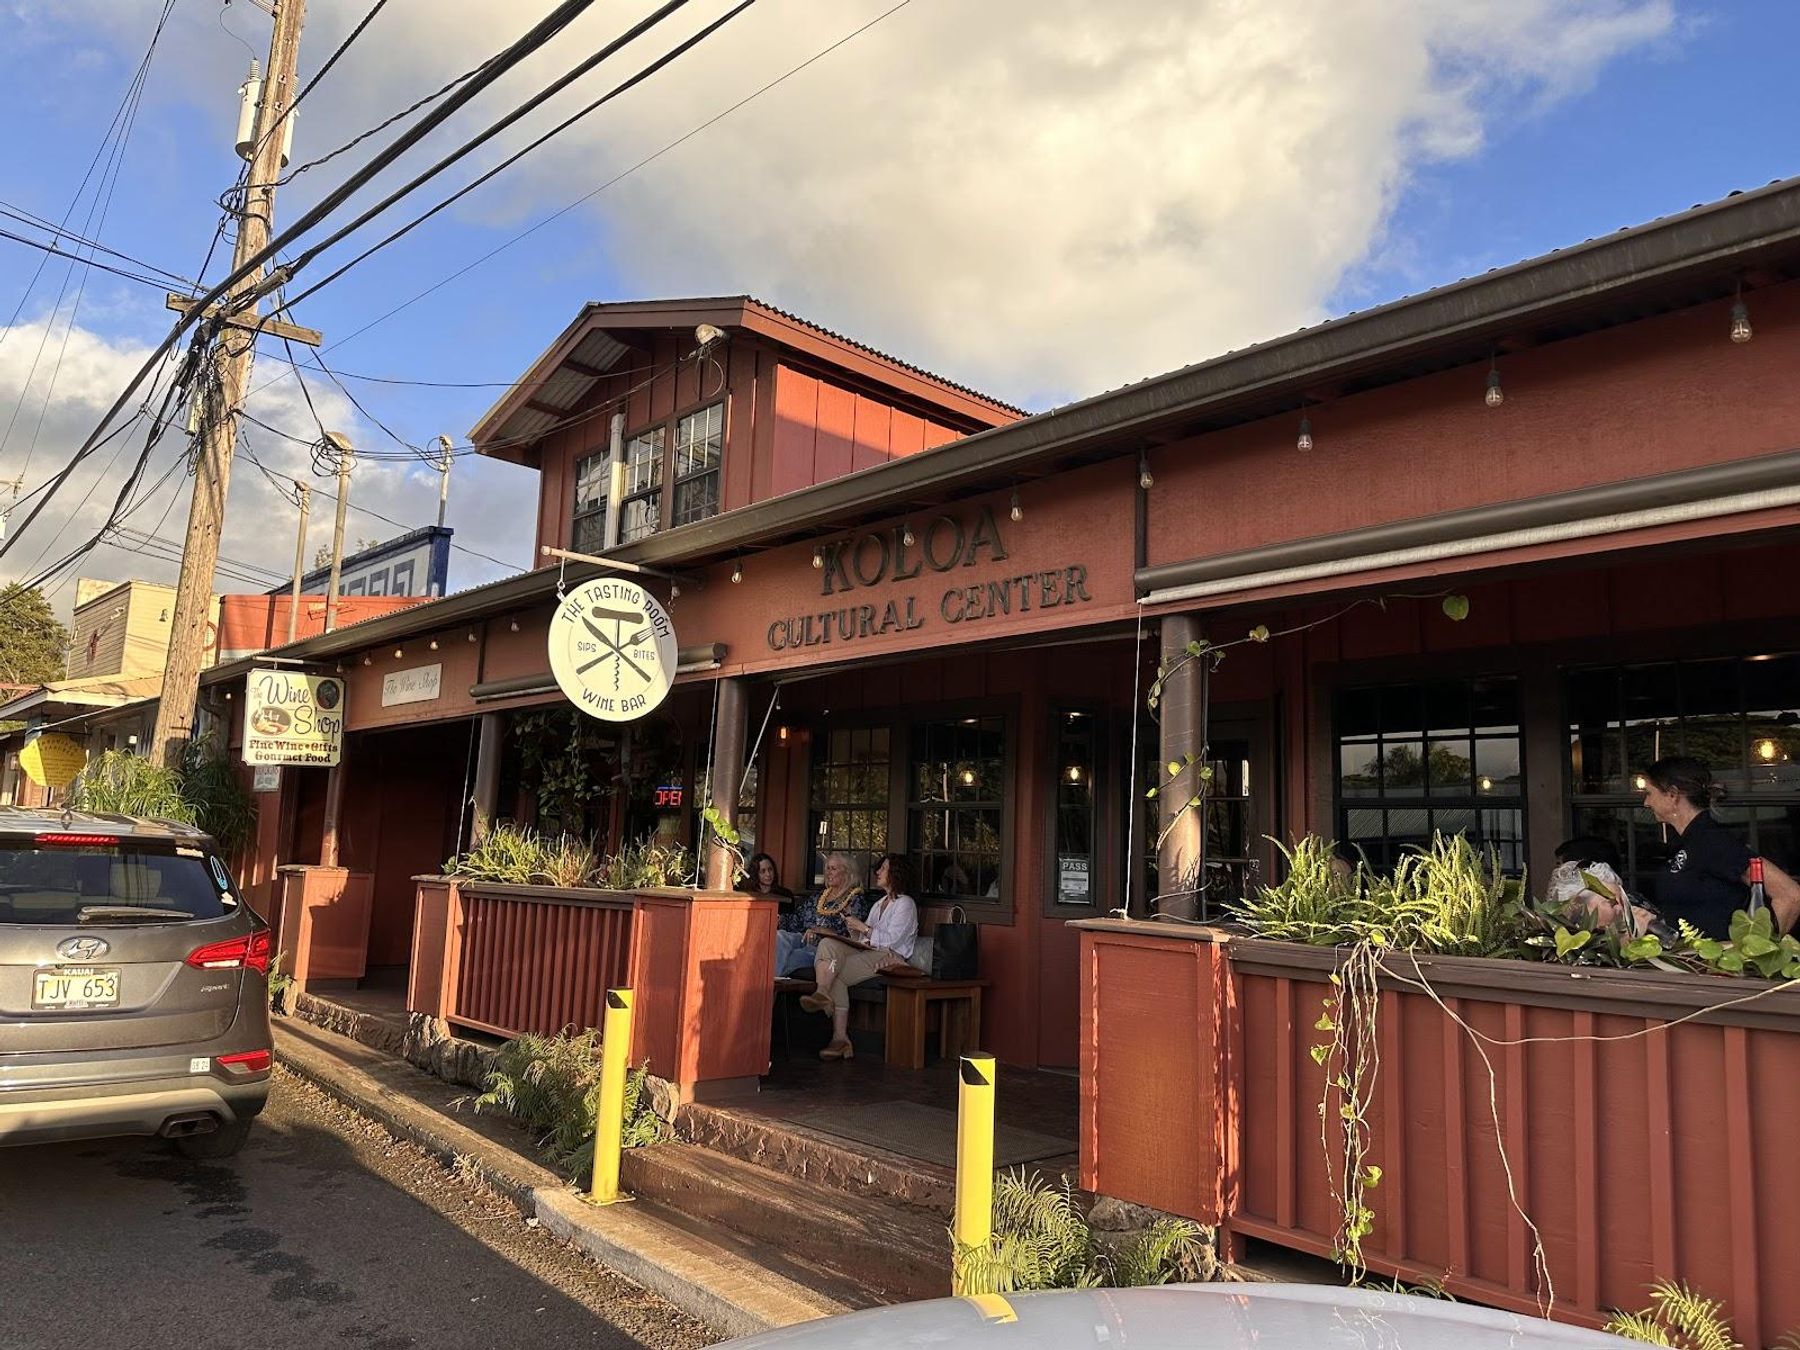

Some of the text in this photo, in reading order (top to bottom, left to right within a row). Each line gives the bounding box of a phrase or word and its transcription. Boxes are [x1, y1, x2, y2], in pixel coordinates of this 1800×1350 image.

[816, 504, 1008, 596] KOLOA
[561, 584, 671, 639] THE TASTING ROOM
[767, 562, 1093, 651] CULTURAL CENTER
[577, 641, 597, 653] SIPS
[633, 649, 655, 661] BITES
[259, 675, 311, 705] Wine
[582, 688, 647, 712] WINE BAR
[294, 705, 340, 744] Shop
[249, 740, 338, 752] Fine Wine Gifts
[255, 751, 331, 763] Gourmet Food
[1062, 862, 1088, 870] PASS
[63, 968, 94, 976] KAUAI
[39, 978, 115, 1000] TJV 653
